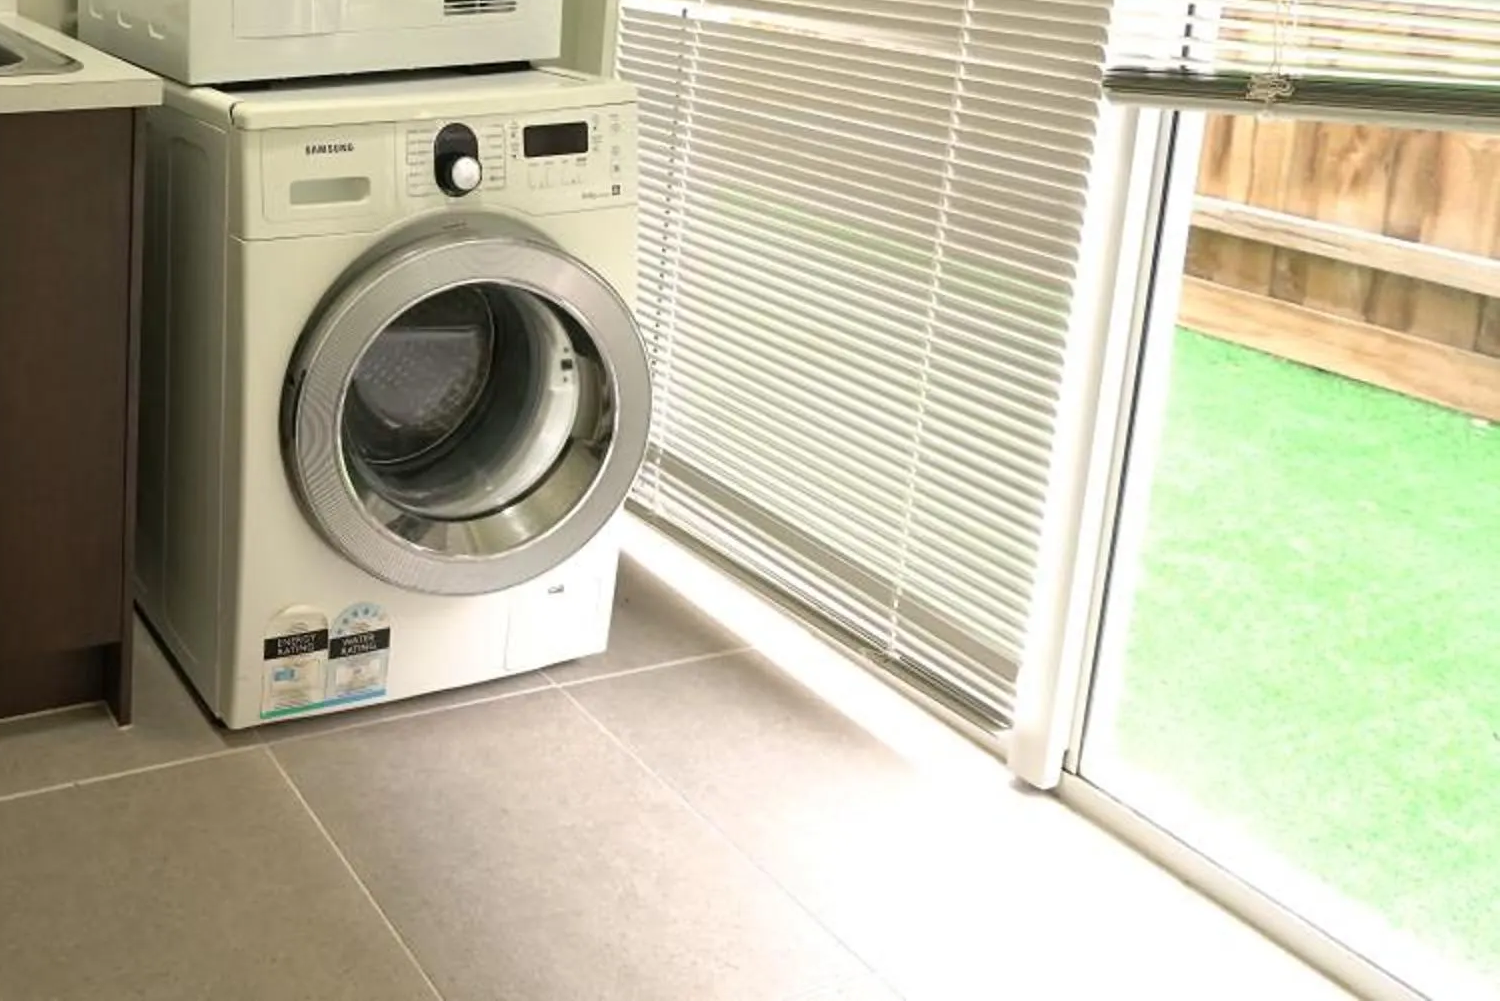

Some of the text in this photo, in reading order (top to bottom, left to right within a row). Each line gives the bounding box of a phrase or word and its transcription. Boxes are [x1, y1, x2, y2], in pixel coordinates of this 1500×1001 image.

[305, 143, 354, 155] SAMSUNG
[277, 634, 317, 647] ENERGY
[341, 633, 376, 646] WATER
